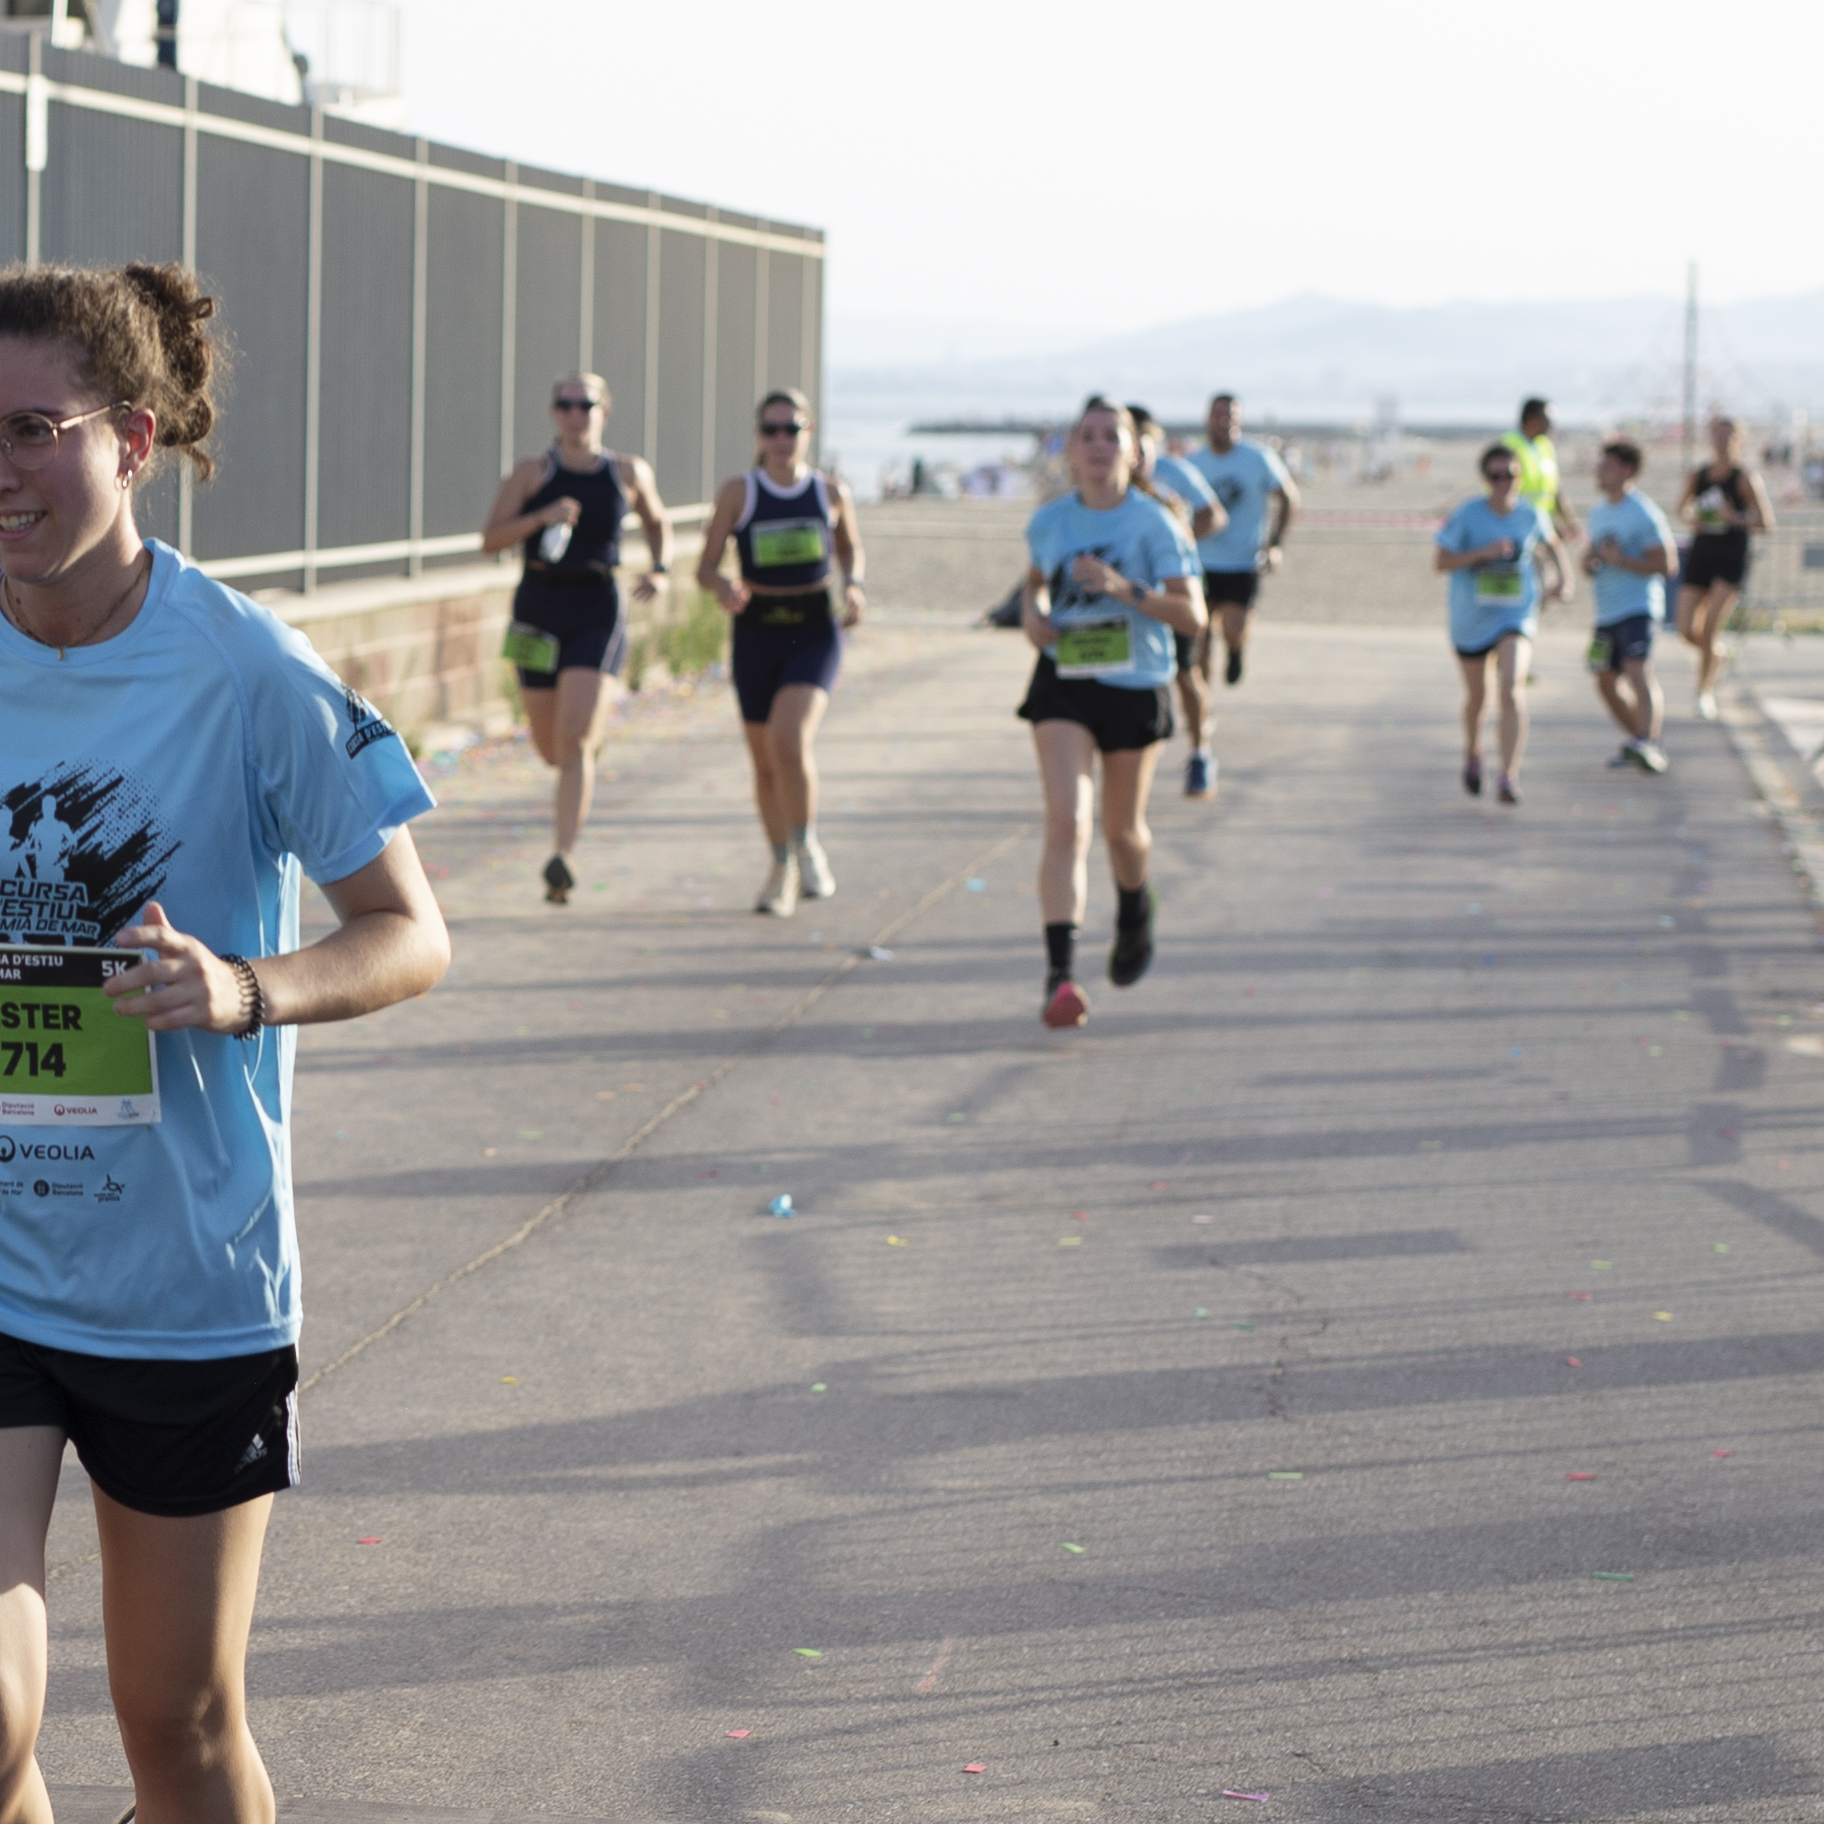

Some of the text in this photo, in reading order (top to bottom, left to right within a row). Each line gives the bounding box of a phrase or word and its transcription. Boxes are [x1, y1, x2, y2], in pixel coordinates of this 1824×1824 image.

[0, 879, 86, 903] CURSA
[36, 919, 59, 931] DE
[61, 920, 97, 935] MAR
[13, 954, 64, 967] D'ESTIU
[101, 960, 128, 977] 5K
[0, 1041, 67, 1078] 714
[66, 1106, 98, 1114] VEOLIA
[19, 1143, 95, 1160] VEOLIA
